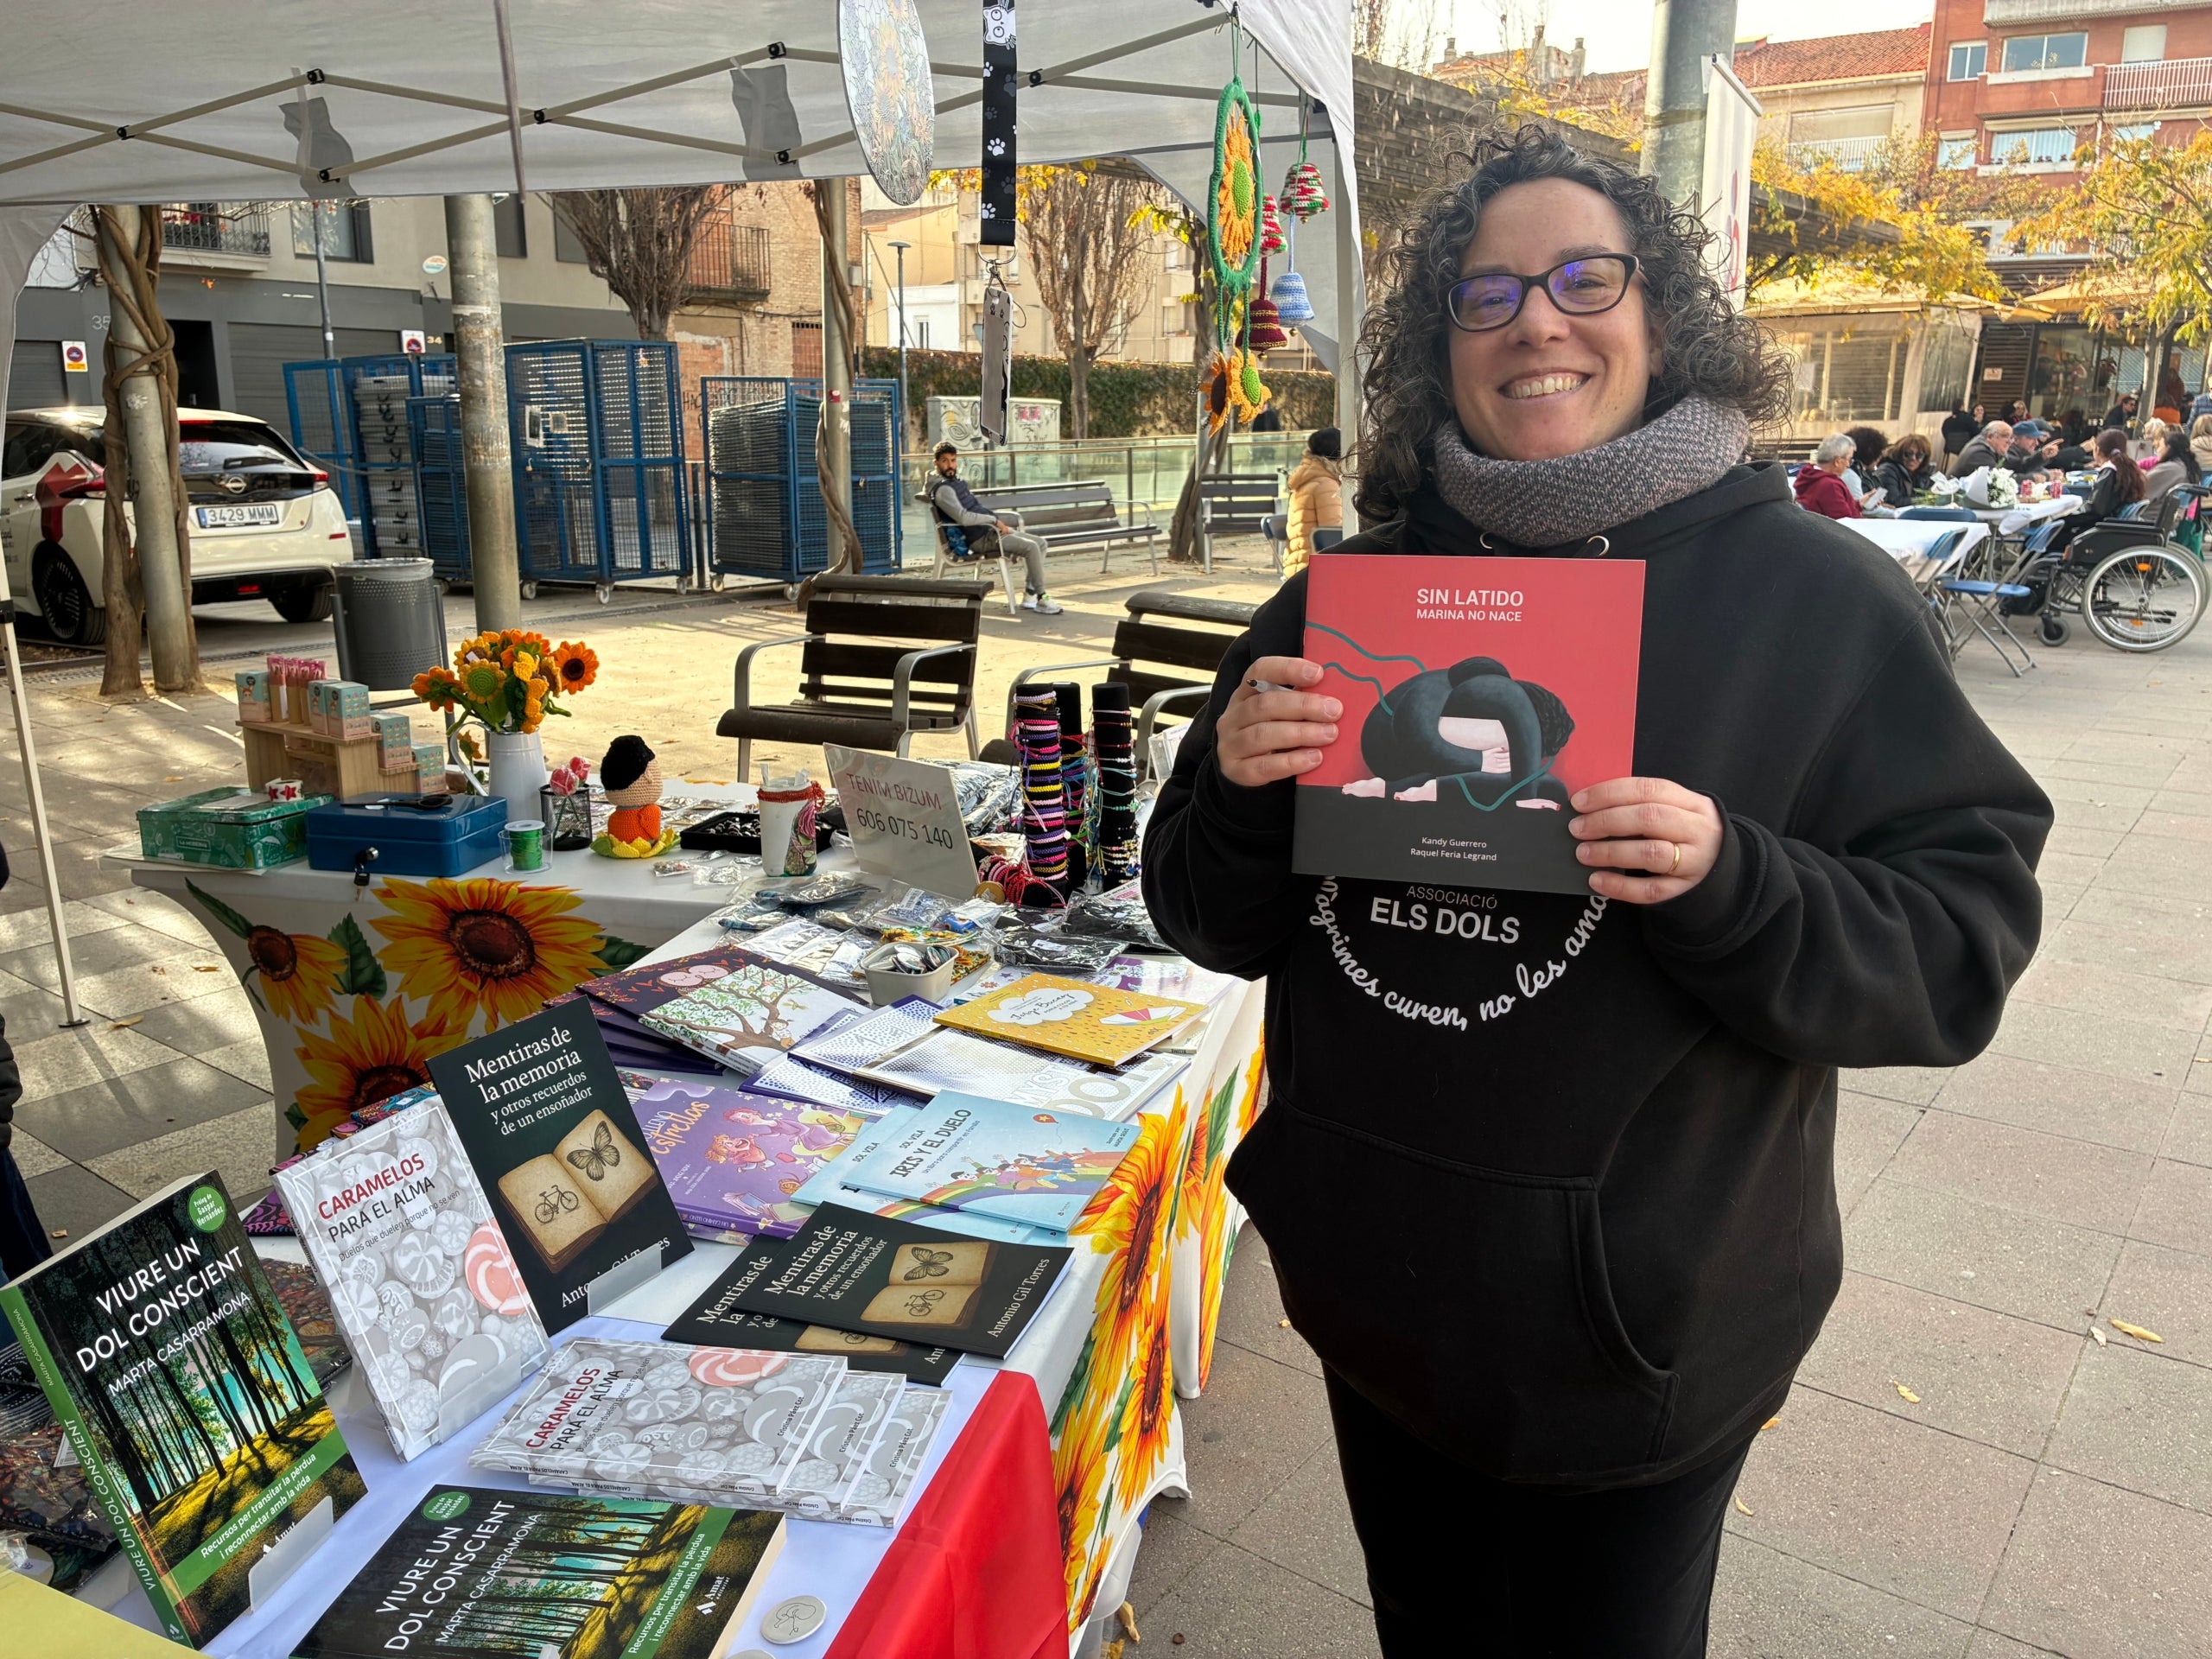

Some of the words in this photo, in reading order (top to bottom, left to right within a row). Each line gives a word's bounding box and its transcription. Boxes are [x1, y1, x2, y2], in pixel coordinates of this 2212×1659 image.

[209, 508, 245, 523] 3429
[249, 506, 275, 520] MMM
[1417, 588, 1449, 605] SIN
[1455, 589, 1523, 607] LATIDO
[1417, 609, 1465, 620] MARINA
[1468, 610, 1485, 621] NO
[1489, 611, 1522, 622] NACE
[847, 773, 892, 799] TENIM
[893, 785, 942, 810] BIZUM
[856, 808, 886, 831] 606
[888, 816, 918, 840] 075
[922, 825, 953, 849] 140
[1421, 836, 1447, 847] Kandy
[1449, 839, 1487, 849] Guerrero
[1410, 848, 1439, 857] Raquel
[1463, 851, 1497, 861] Legrand
[1370, 897, 1427, 931] ELS
[1435, 908, 1520, 944] DOLS
[1407, 886, 1497, 909] ASSOCIACIÓ
[1479, 994, 1516, 1021] no
[1516, 960, 1567, 998] les
[464, 1038, 550, 1083] Mentiras
[551, 1027, 572, 1047] de
[478, 1084, 500, 1103] la
[499, 1051, 582, 1095] memoria
[491, 1111, 498, 1125] y
[501, 1096, 531, 1116] otros
[532, 1071, 587, 1103] recuerdos
[501, 1122, 516, 1135] de
[517, 1115, 535, 1128] un
[536, 1087, 592, 1119] ensoñador
[852, 1154, 867, 1163] SOL
[861, 1143, 879, 1153] VILA
[889, 1156, 924, 1177] IRIS
[921, 1139, 945, 1147] EL
[934, 1109, 971, 1137] DUELO
[899, 1141, 913, 1149] SOL
[908, 1130, 925, 1140] VILA
[197, 1200, 215, 1215] Gaspar
[318, 1154, 424, 1219] CARAMELOS
[328, 1210, 372, 1243] PARA
[372, 1200, 392, 1218] EL
[394, 1177, 435, 1209] ALMA
[339, 1241, 365, 1262] Duelos
[365, 1236, 378, 1248] que
[379, 1222, 404, 1239] duelen
[404, 1208, 429, 1228] porque
[429, 1202, 439, 1211] no
[439, 1198, 448, 1206] se
[448, 1190, 460, 1200] ven
[95, 1260, 166, 1314] VIURE
[164, 1237, 200, 1270] UN
[764, 1240, 824, 1294] Mentiras
[814, 1226, 836, 1240] de
[786, 1285, 811, 1296] la
[804, 1231, 858, 1284] memoria
[819, 1274, 842, 1293] otros
[836, 1236, 873, 1273] recuerdos
[828, 1290, 843, 1300] de
[840, 1279, 855, 1289] un
[850, 1239, 887, 1278] ensoñador
[1021, 1259, 1049, 1286] Torres
[76, 1328, 129, 1372] DOL
[130, 1246, 242, 1336] CONSCIENT
[696, 1268, 762, 1325] Mentiras
[754, 1255, 772, 1273] de
[1013, 1287, 1032, 1301] Gil
[13, 1308, 42, 1362] CASARRAMONA
[109, 1357, 157, 1396] MARTA
[157, 1292, 251, 1362] CASARRAMONA
[720, 1313, 745, 1325] la
[764, 1317, 779, 1329] de
[987, 1302, 1020, 1338] Antonio
[38, 1361, 54, 1386] MARTA
[525, 1369, 600, 1448] CARAMELOS
[549, 1419, 586, 1450] PARA
[576, 1404, 598, 1417] EL
[589, 1370, 624, 1402] ALMA
[575, 1433, 596, 1452] Duelos
[593, 1422, 605, 1433] que
[601, 1402, 620, 1421] duelen
[613, 1382, 633, 1402] porque
[640, 1357, 652, 1367] ven
[777, 1417, 793, 1436] Cristina
[788, 1405, 800, 1417] Páez
[795, 1396, 804, 1405] Cot
[64, 1419, 109, 1496] CONSCIENT
[838, 1434, 855, 1452] Cristina
[849, 1422, 861, 1433] Páez
[889, 1449, 905, 1467] Cristina
[899, 1437, 912, 1448] Páez
[105, 1497, 124, 1525] DOL
[200, 1523, 238, 1558] Recursos
[238, 1510, 251, 1528] per
[251, 1483, 282, 1514] transitar
[282, 1477, 290, 1486] la
[290, 1453, 316, 1481] pèrdua
[225, 1511, 270, 1555] reconnectar
[270, 1496, 287, 1515] amb
[286, 1489, 296, 1499] la
[294, 1475, 311, 1491] vida
[435, 1498, 453, 1514] Gaspar
[119, 1529, 136, 1548] UN
[131, 1551, 156, 1591] VIURE
[375, 1558, 438, 1612] VIURE
[425, 1527, 463, 1553] UN
[384, 1609, 434, 1649] DOL
[423, 1500, 515, 1604] CONSCIENT
[435, 1601, 476, 1643] MARTA
[469, 1514, 542, 1599] CASARRAMONA
[627, 1617, 657, 1653] Recursos
[652, 1602, 665, 1616] per
[659, 1569, 684, 1601] transitar
[685, 1534, 705, 1560] pèrdua
[654, 1590, 686, 1637] reconnectar
[683, 1571, 697, 1589] amb
[697, 1546, 712, 1561] vida
[704, 1576, 724, 1600] Amat
[712, 1577, 730, 1599] editorial
